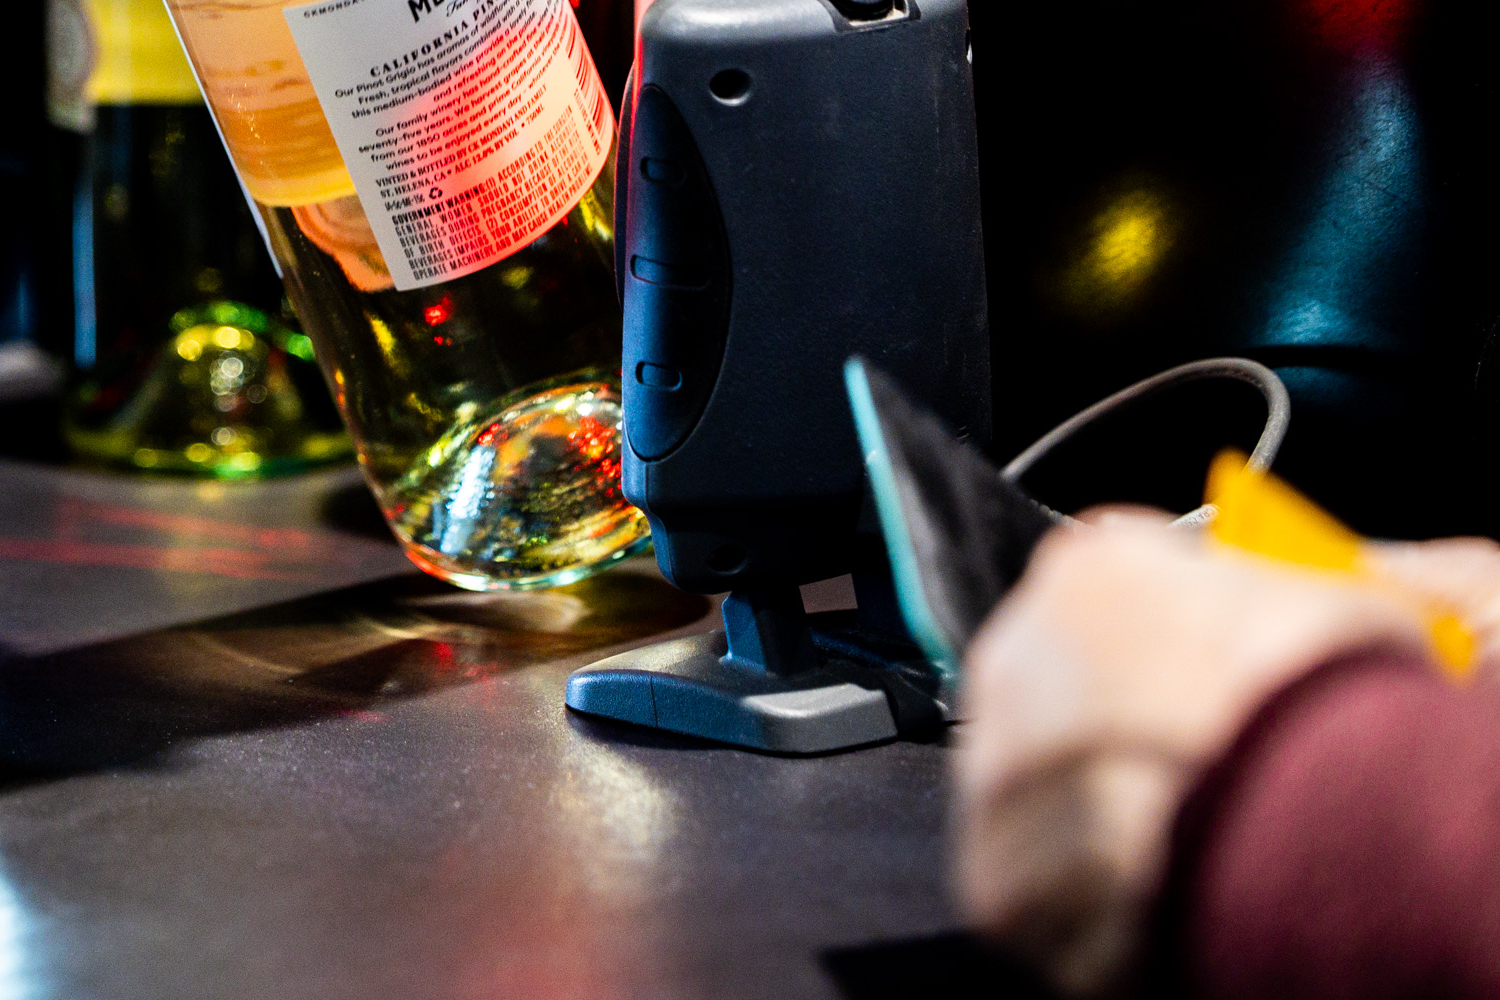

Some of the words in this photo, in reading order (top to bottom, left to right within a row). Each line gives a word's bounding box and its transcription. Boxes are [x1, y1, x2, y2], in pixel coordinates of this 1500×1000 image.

[334, 88, 354, 99] Our
[356, 79, 384, 93] Pinot
[385, 65, 416, 83] Grigio
[417, 57, 435, 70] has
[436, 35, 469, 60] aromas
[471, 25, 479, 37] of
[351, 107, 371, 118] this
[373, 73, 452, 113] medium-bodied
[453, 60, 474, 76] wine
[475, 35, 504, 63] provide
[510, 7, 527, 30] lovely
[358, 91, 389, 105] Fresh,
[391, 72, 430, 95] tropical
[431, 52, 463, 77] flavors
[464, 20, 501, 56] combined
[502, 6, 515, 23] with
[358, 129, 422, 153] seventy-five
[424, 115, 453, 134] years.
[454, 104, 470, 117] We
[471, 82, 502, 107] harvest
[503, 58, 526, 86] grapes
[526, 48, 534, 59] at
[534, 31, 545, 50] their
[370, 20, 469, 78] CALIFORNIA
[375, 126, 394, 137] Our
[396, 112, 428, 131] family
[430, 96, 461, 117] winery
[462, 85, 479, 99] has
[479, 40, 527, 86] hand-crafted
[527, 26, 537, 41] fine
[538, 7, 548, 27] wines
[433, 86, 452, 102] and
[454, 56, 496, 90] refreshing
[497, 48, 506, 60] on
[506, 34, 518, 50] the
[518, 11, 536, 39] palate.
[370, 150, 395, 162] from
[397, 145, 414, 156] our
[416, 132, 440, 149] 1850
[442, 119, 468, 137] acres
[469, 106, 487, 123] and
[488, 90, 511, 112] prime
[511, 56, 541, 90] California
[375, 172, 409, 188] VINTED
[417, 152, 456, 176] BOTTLED
[456, 147, 468, 160] BY
[467, 141, 479, 153] CK
[479, 116, 514, 145] MONDAVI
[514, 105, 528, 121] AND
[527, 83, 547, 109] FAMILY
[380, 188, 394, 198] ST.
[394, 177, 434, 195] HELENA,
[434, 172, 446, 183] CA
[454, 160, 471, 174] ALC
[494, 138, 504, 152] BY
[526, 103, 544, 126] 750ML
[386, 156, 415, 171] wines
[416, 151, 428, 161] to
[429, 145, 442, 156] be
[444, 123, 482, 149] enjoyed
[483, 107, 506, 127] every
[507, 94, 521, 109] day
[528, 55, 552, 89] whatever
[391, 202, 445, 226] GOVERNMENT
[497, 146, 536, 183] ACCORDING
[535, 140, 544, 154] TO
[543, 129, 554, 145] THE
[553, 104, 573, 133] SURGEON
[394, 218, 438, 237] GENERAL,
[439, 202, 473, 224] WOMEN
[477, 181, 510, 208] SHOULD
[511, 169, 526, 187] NOT
[527, 151, 549, 175] DRINK
[550, 115, 576, 153] ALCOHOLIC
[399, 226, 447, 248] BEVERAGES
[447, 211, 480, 233] DURING
[480, 186, 524, 219] PREGNANCY
[524, 163, 552, 192] BECAUSE
[551, 153, 560, 168] OF
[559, 144, 569, 160] THE
[403, 247, 414, 259] OF
[418, 239, 445, 255] BIRTH
[485, 216, 498, 231] (2)
[499, 182, 548, 223] CONSUMPTION
[547, 173, 557, 187] OF
[408, 248, 454, 270] BEVERAGES
[454, 233, 490, 254] IMPAIRS
[490, 222, 512, 241] YOUR
[512, 202, 540, 229] ABILITY
[540, 195, 550, 210] TO
[549, 178, 567, 200] DRIVE
[571, 161, 581, 177] CAR
[413, 263, 448, 281] OPERATE
[449, 243, 496, 271] MACHINERY,
[495, 235, 512, 252] AND
[511, 226, 528, 243] MAY
[528, 211, 549, 233] CAUSE
[548, 190, 570, 217] HEALTH
